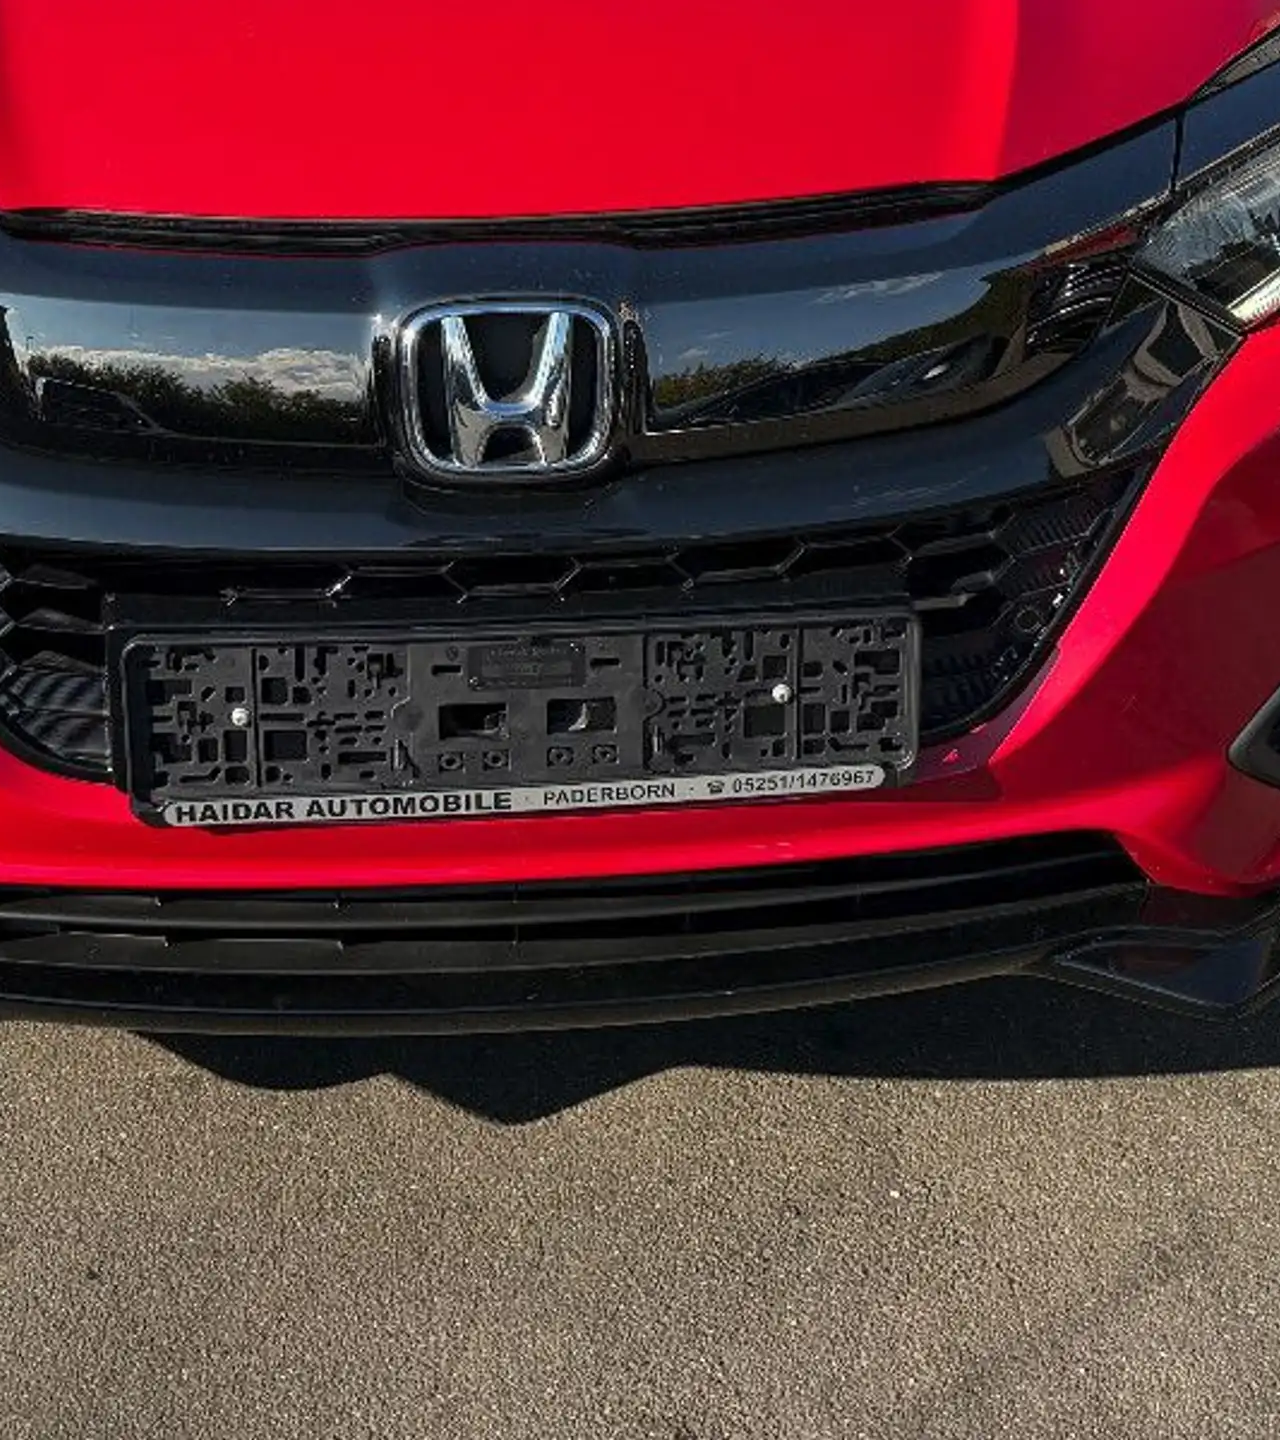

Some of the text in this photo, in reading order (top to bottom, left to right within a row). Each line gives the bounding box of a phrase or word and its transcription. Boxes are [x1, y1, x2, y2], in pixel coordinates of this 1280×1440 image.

[175, 800, 295, 823] HAIDAR
[306, 791, 513, 818] AUTOMOBILE
[543, 783, 676, 806] PADERBORN
